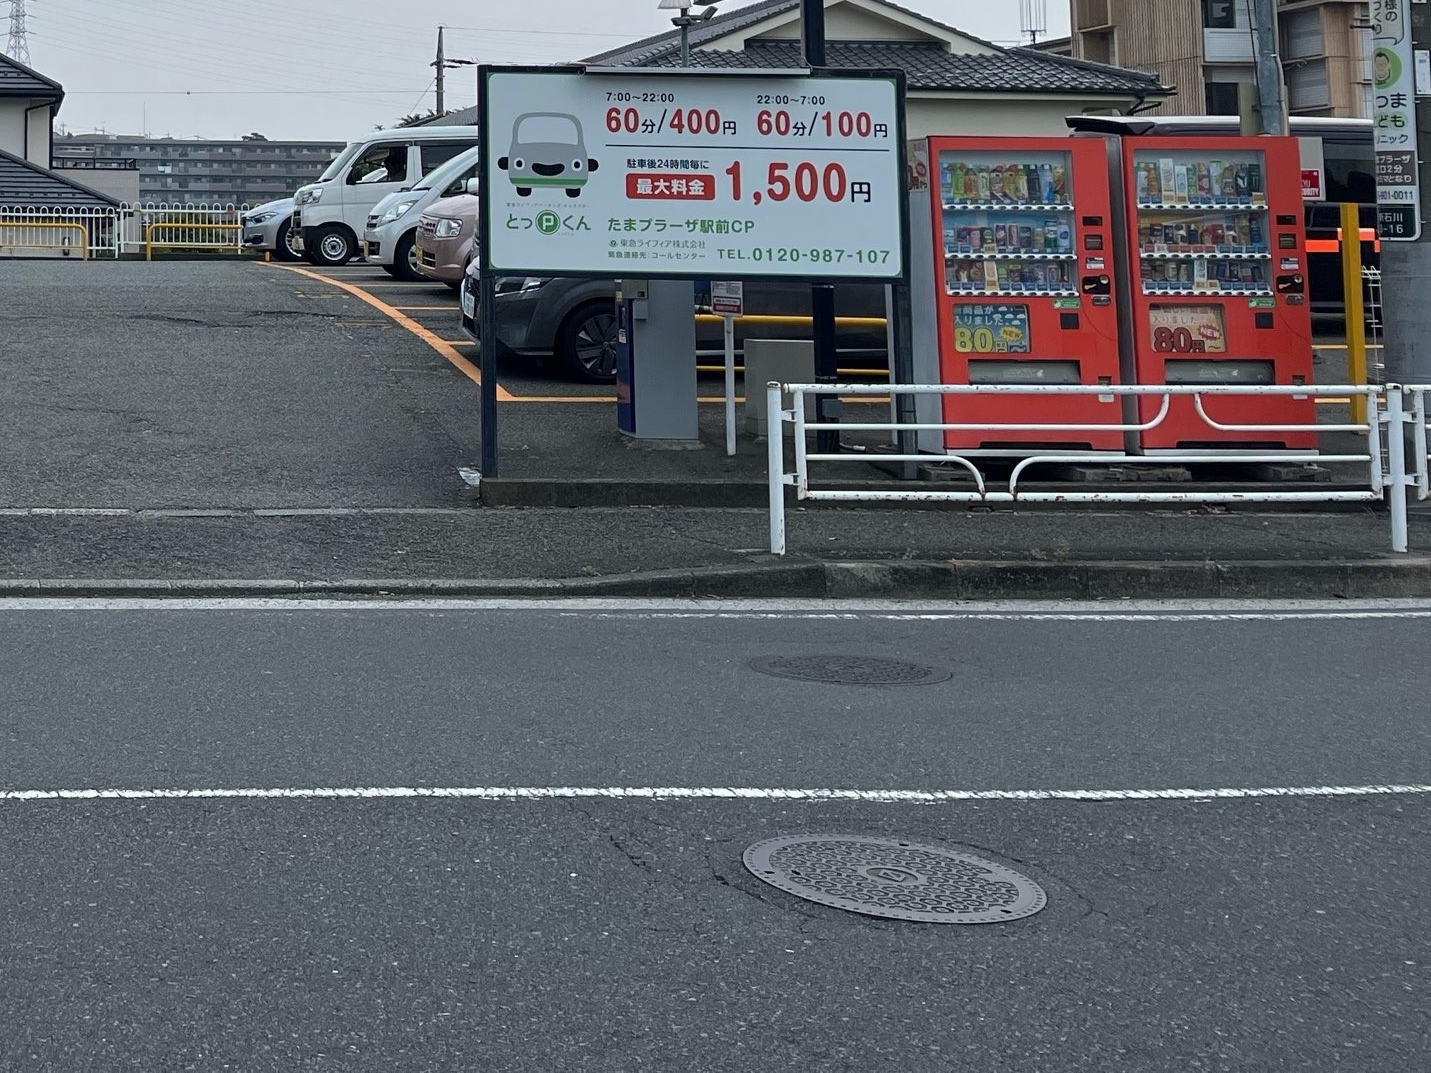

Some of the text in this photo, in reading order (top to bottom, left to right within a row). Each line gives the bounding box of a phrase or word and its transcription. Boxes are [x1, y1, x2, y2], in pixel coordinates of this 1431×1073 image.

[1376, 92, 1407, 108] つま
[606, 107, 737, 135] 60分/400円
[757, 110, 888, 138] 60分/100円
[1374, 114, 1405, 128] ども
[626, 158, 710, 170] 駐車後24時間毎に
[636, 178, 705, 196] 最大料金
[725, 161, 871, 205] 1,500円
[607, 217, 755, 234] たまプラーザ駅前CP
[717, 247, 891, 264] TEL.0120-987-107
